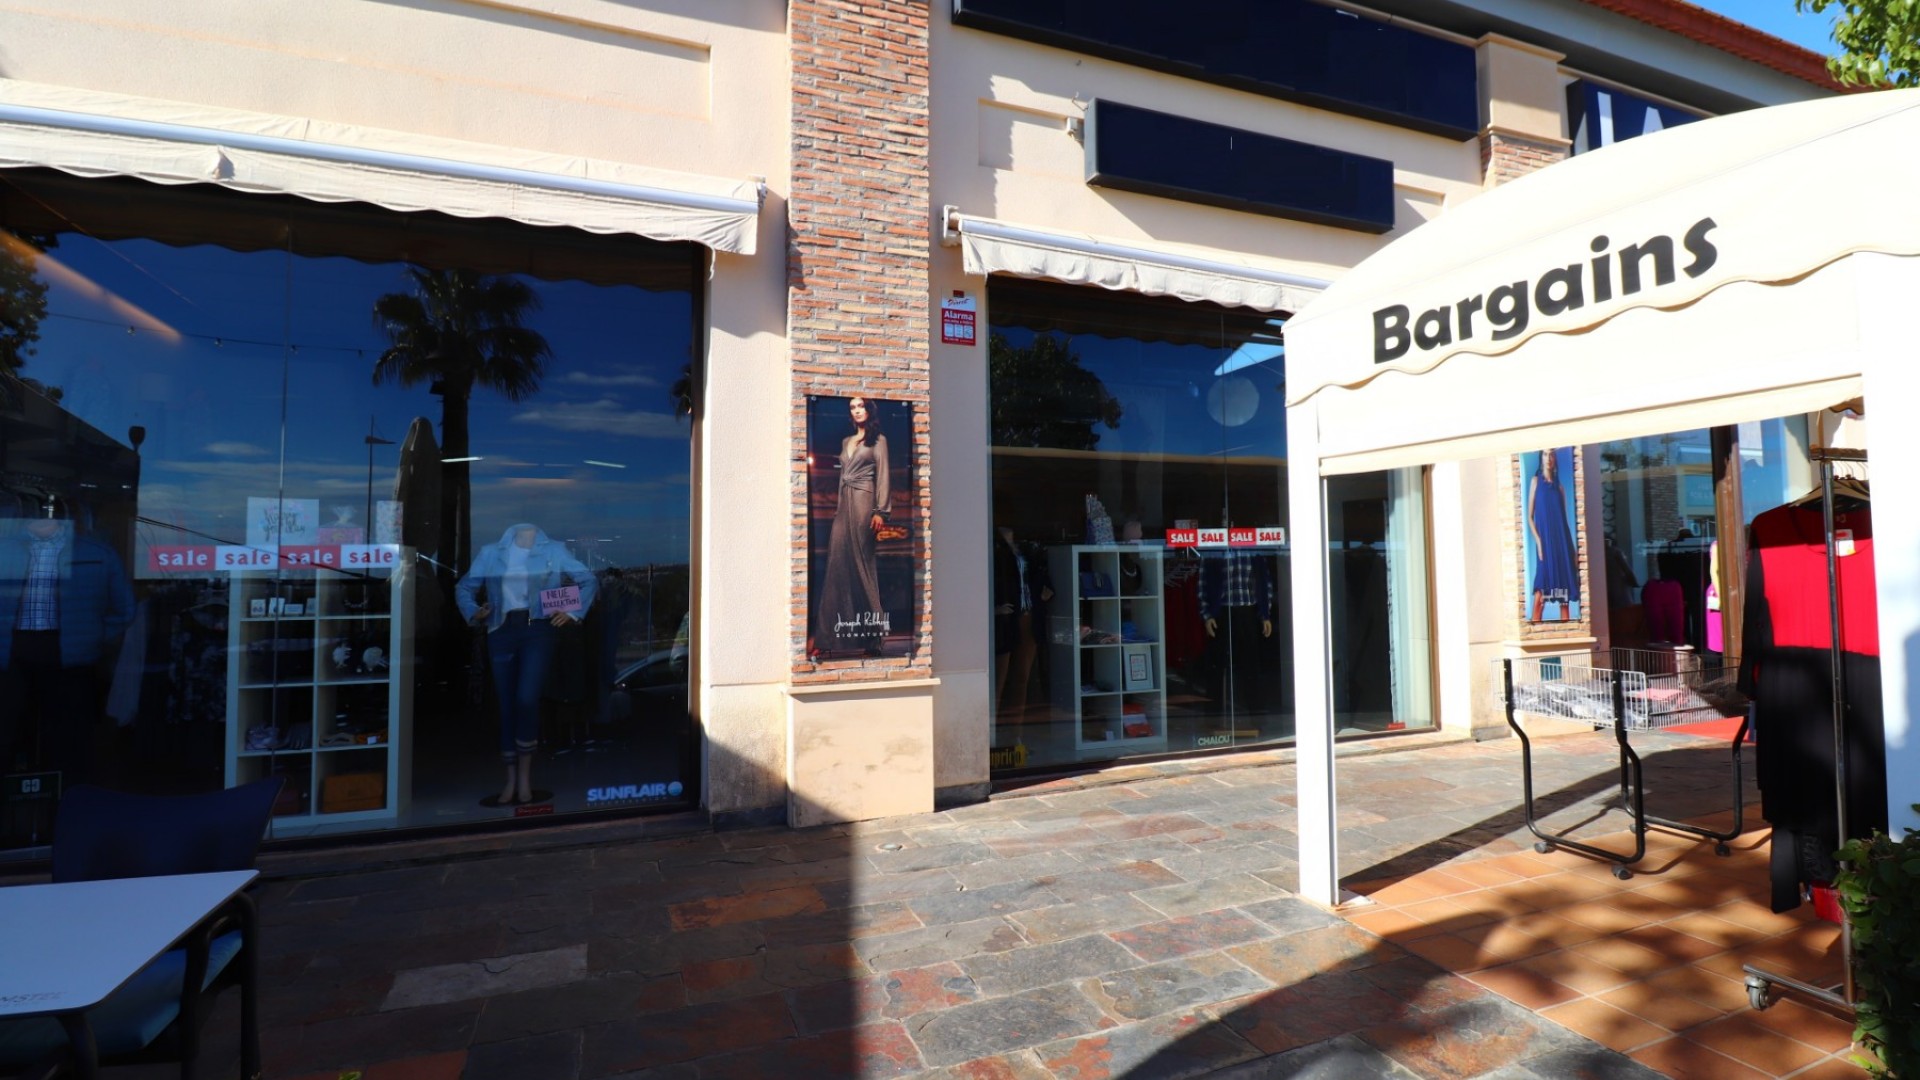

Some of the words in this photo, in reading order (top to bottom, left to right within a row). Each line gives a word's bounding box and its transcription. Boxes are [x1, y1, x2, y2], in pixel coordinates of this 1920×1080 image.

[1373, 216, 1718, 364] Bargains
[944, 310, 974, 321] Alarma
[1170, 533, 1195, 543] SALE
[1201, 532, 1225, 542] SALE
[1230, 532, 1253, 542] SALE
[1259, 531, 1281, 541] SALE
[157, 551, 208, 566] sale
[224, 549, 271, 565] sale
[287, 549, 334, 565] sale
[349, 548, 394, 564] sale
[834, 612, 861, 632] Joseph
[587, 783, 667, 802] SUNFLAIR
